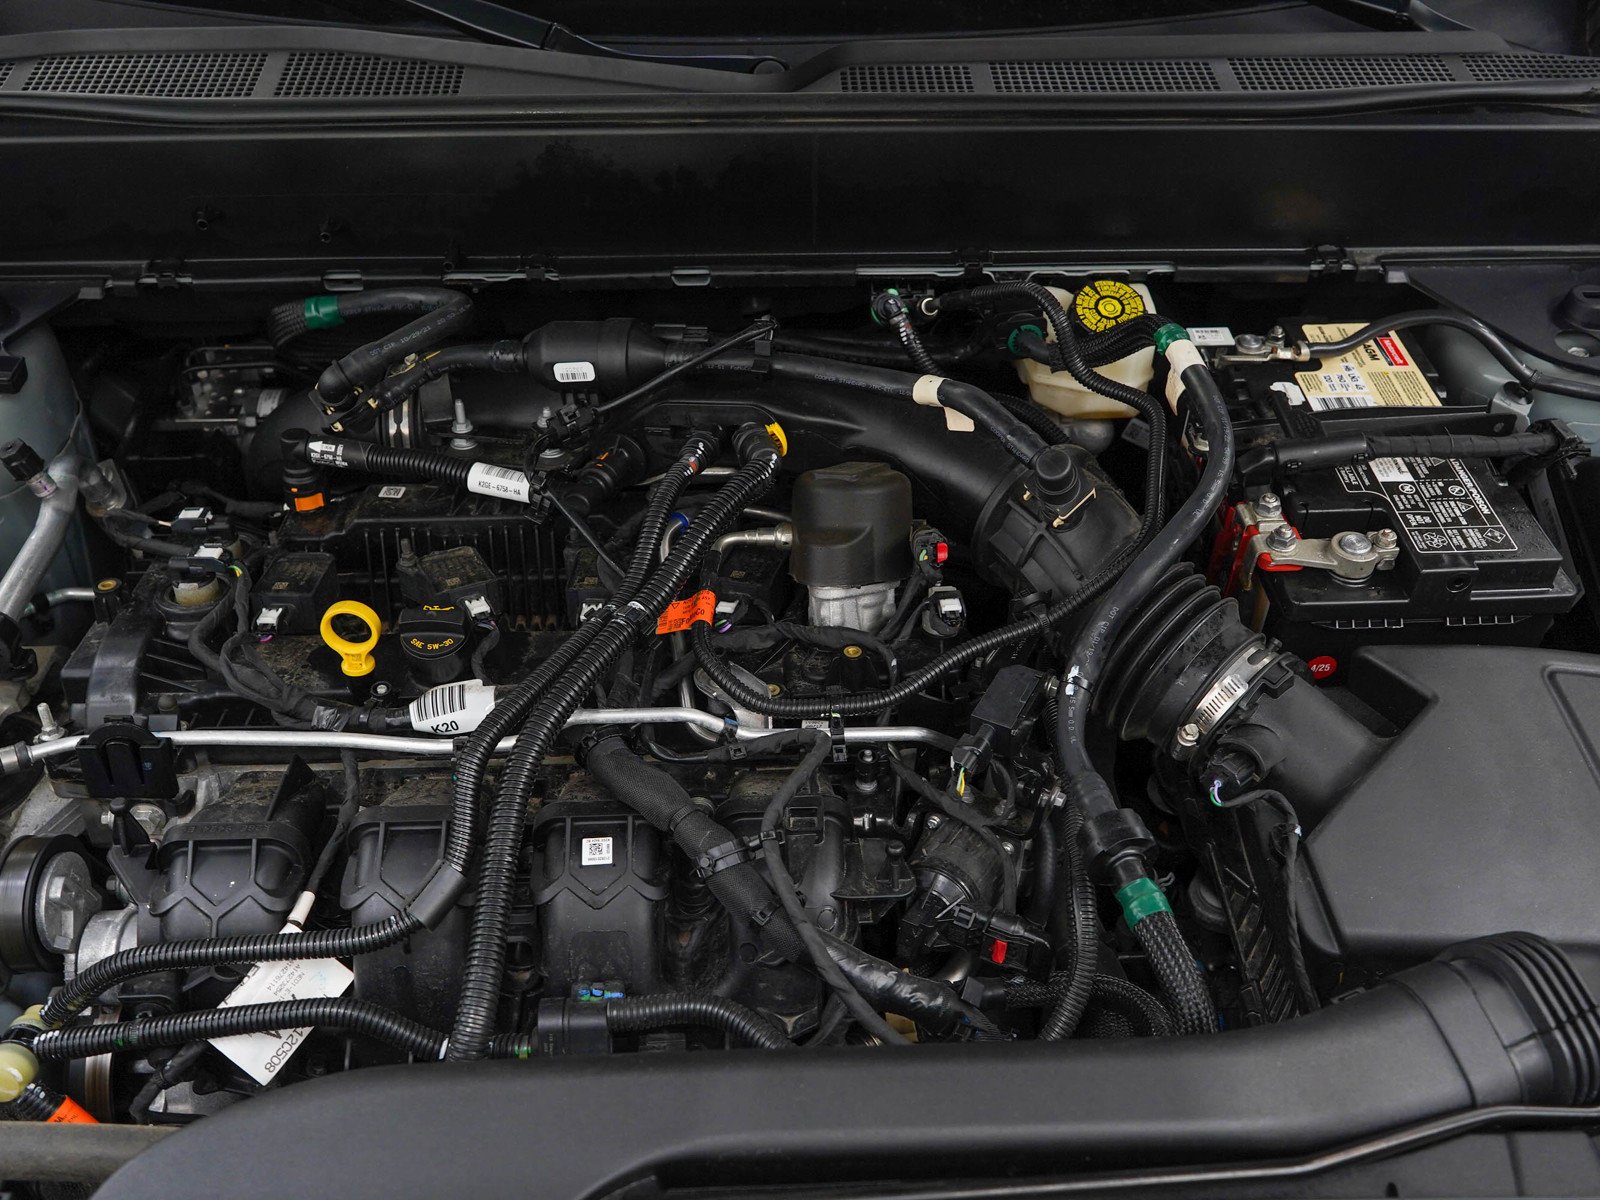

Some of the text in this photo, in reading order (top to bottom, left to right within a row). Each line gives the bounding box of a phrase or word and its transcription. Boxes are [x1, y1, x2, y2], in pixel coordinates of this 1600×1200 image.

[1362, 344, 1381, 361] AGM
[1450, 462, 1492, 515] DANGER/POISON
[1414, 516, 1426, 525] NOT
[410, 638, 454, 650] SAE 5W-30
[1311, 663, 1331, 672] 4/25
[430, 720, 459, 733] K20
[264, 1027, 304, 1074] 12C508
